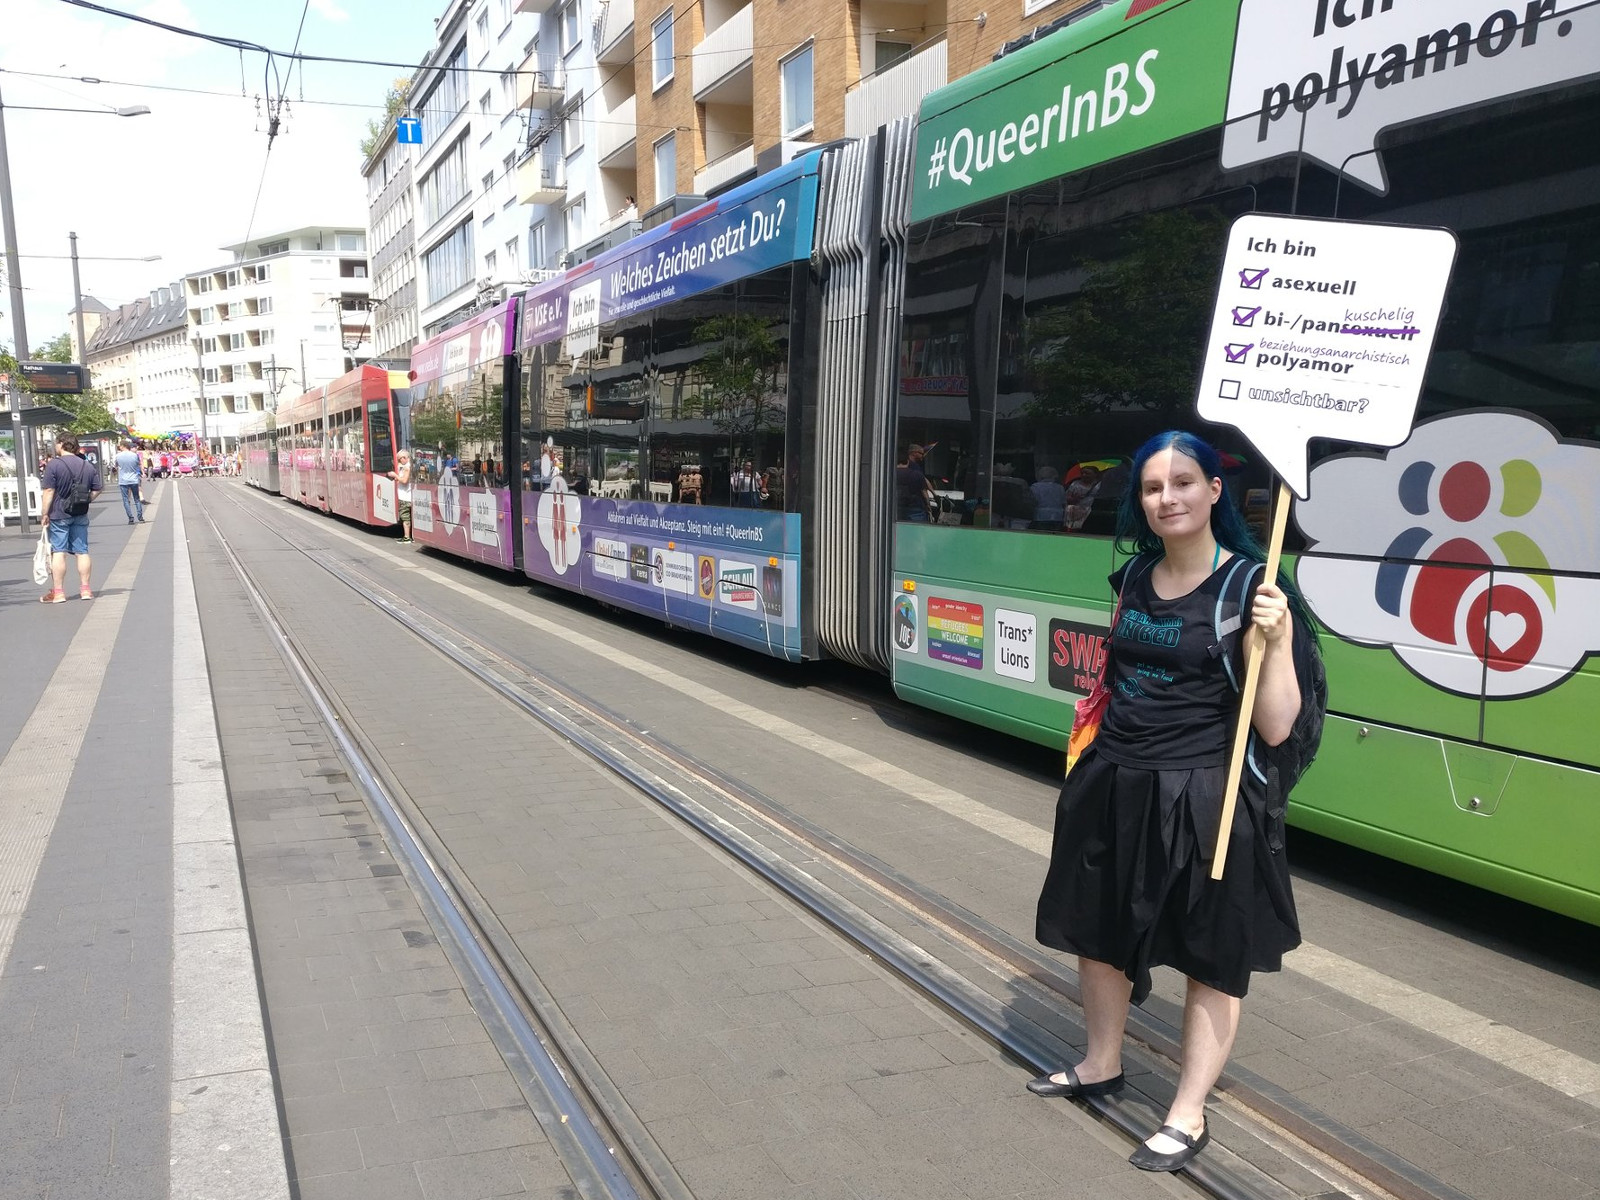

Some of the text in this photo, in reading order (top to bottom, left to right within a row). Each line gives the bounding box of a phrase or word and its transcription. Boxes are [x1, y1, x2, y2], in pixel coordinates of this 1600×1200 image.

[1257, 0, 1573, 142] polyamor.
[401, 119, 417, 142] T
[928, 49, 1159, 189] #QueerInBS
[610, 198, 786, 299] Welches Zeichen setzt Du?
[1247, 237, 1317, 257] Ich bin
[1272, 276, 1357, 296] asexuell
[534, 296, 563, 327] VSE e.V.
[572, 294, 596, 318] Ich bin
[1344, 307, 1415, 325] kuschelig
[1256, 352, 1354, 374] polyamor
[1259, 337, 1410, 366] beziehungsanarchistisch
[1249, 387, 1370, 414] unsichtbar?
[633, 514, 650, 527] Vielfalt
[650, 516, 659, 529] und
[659, 517, 686, 534] Akzeptanz.
[687, 520, 701, 537] Steig
[702, 522, 712, 536] mit
[713, 523, 725, 537] ein!
[725, 524, 764, 542] #QueerInBS
[723, 572, 754, 591] SCHLAU
[941, 619, 969, 633] REFUGEES
[1138, 625, 1181, 648] BED
[941, 631, 969, 645] WELCOME
[1001, 647, 1029, 669] Lions
